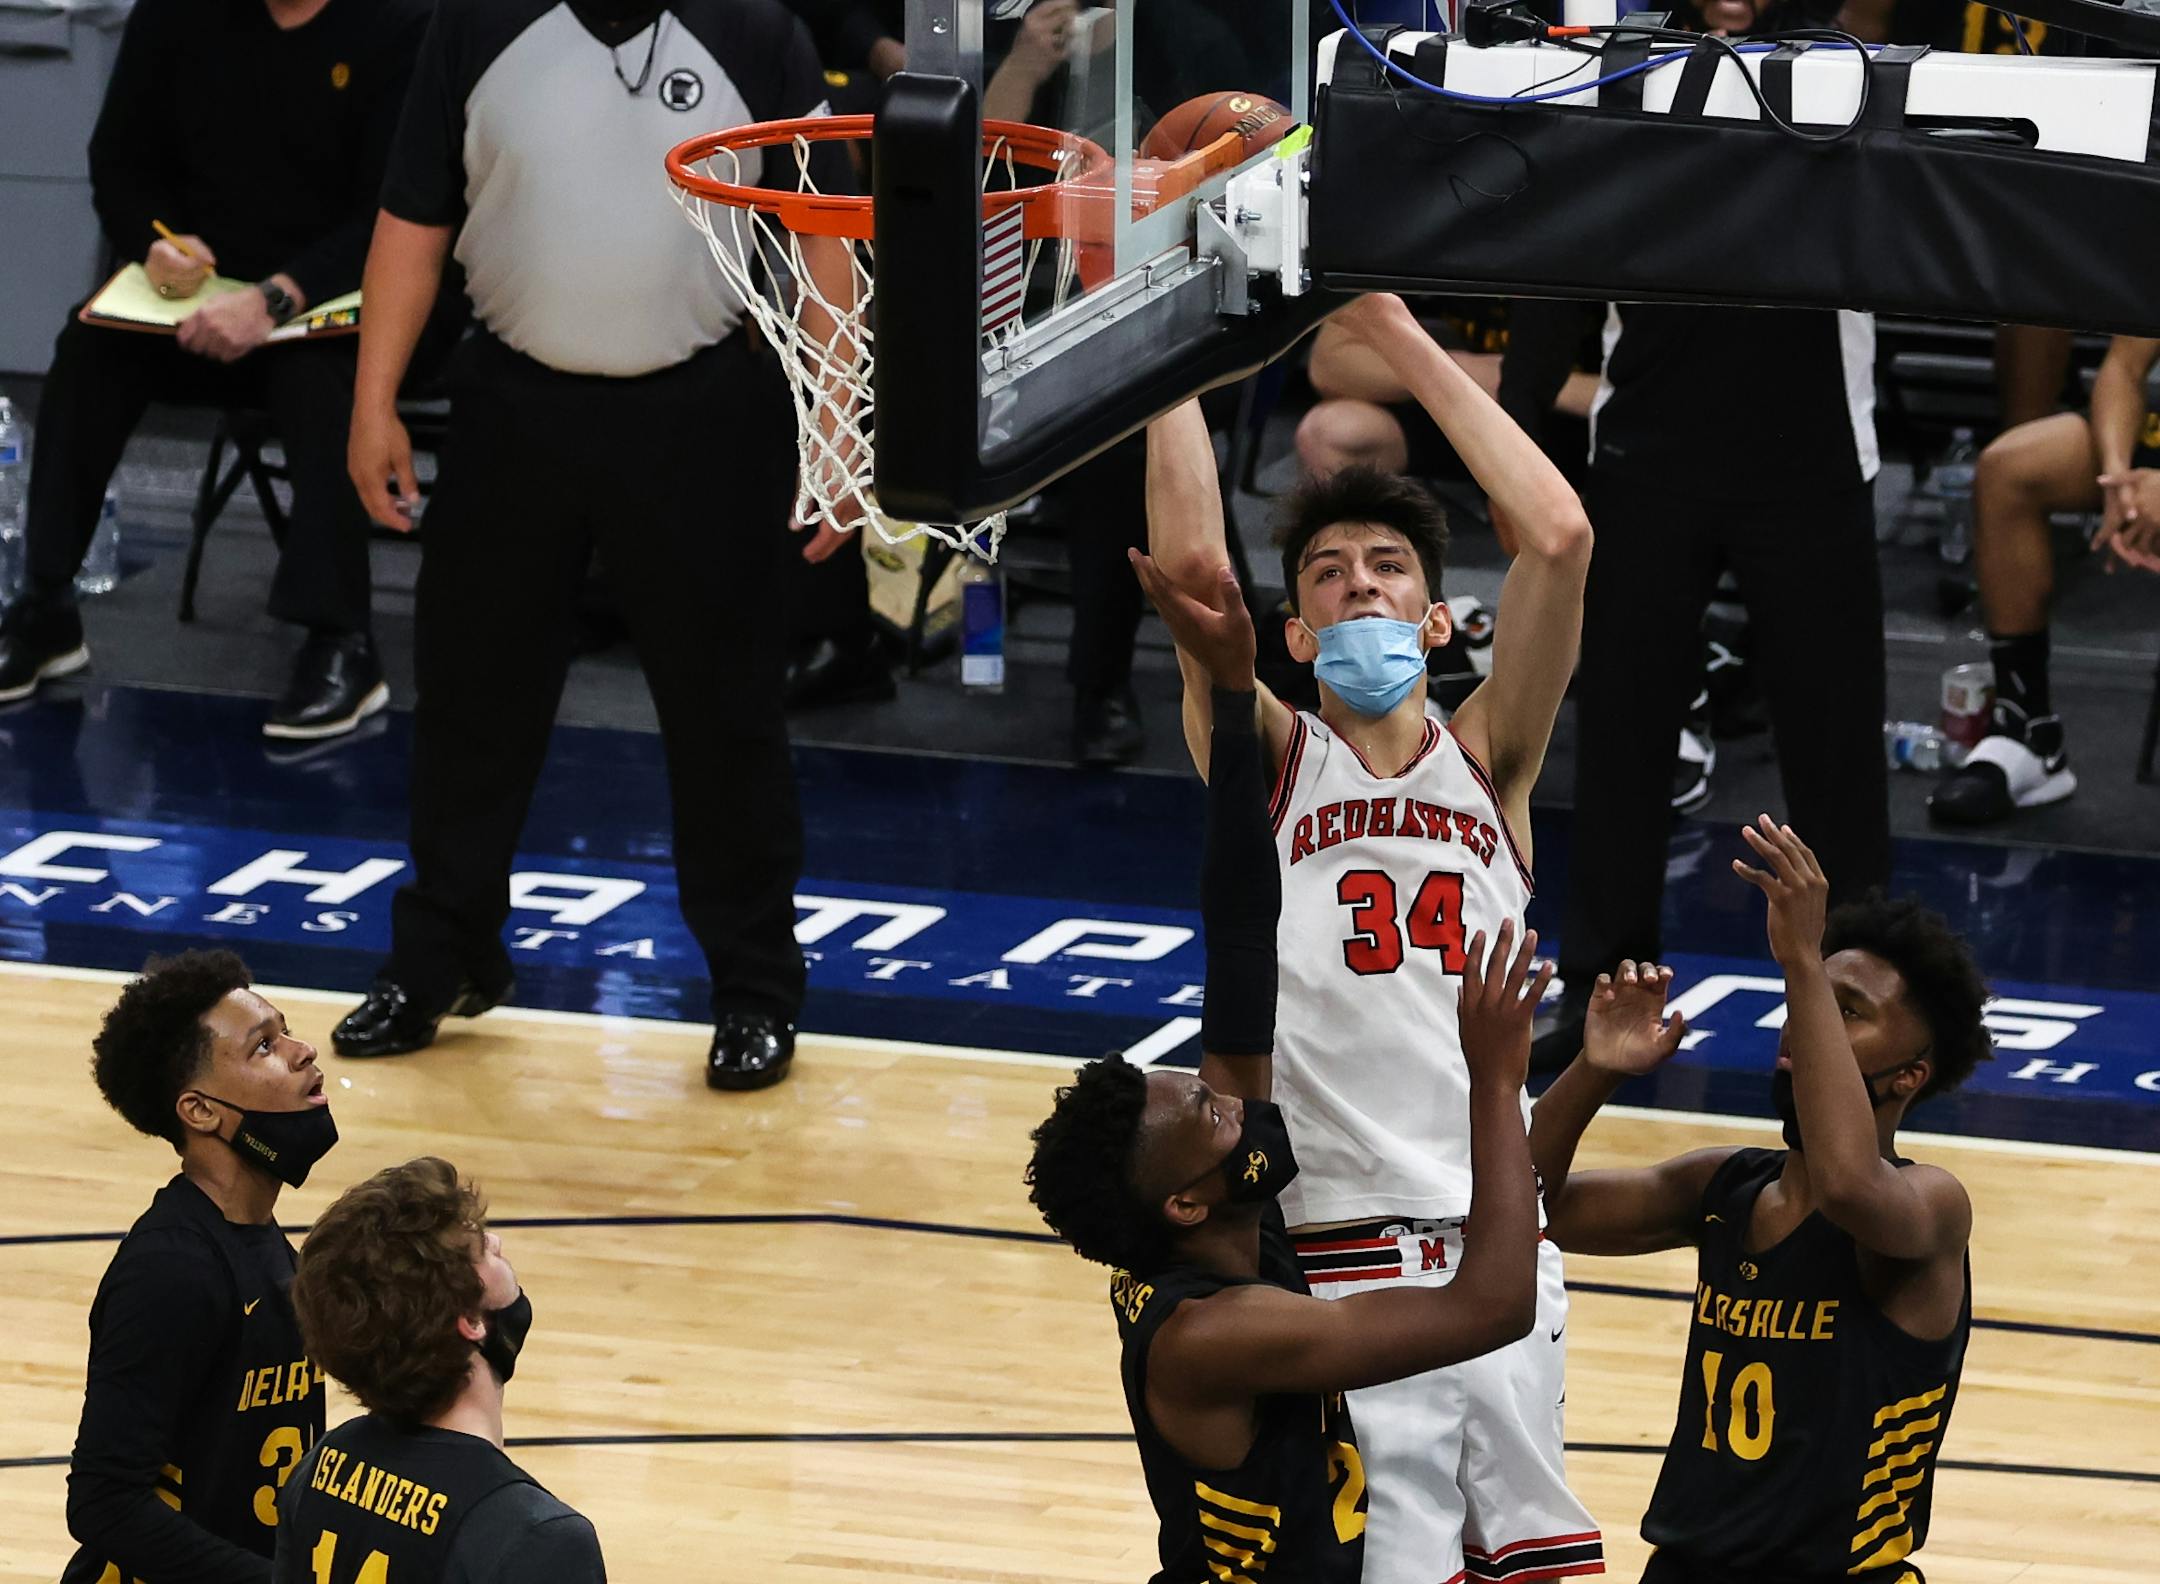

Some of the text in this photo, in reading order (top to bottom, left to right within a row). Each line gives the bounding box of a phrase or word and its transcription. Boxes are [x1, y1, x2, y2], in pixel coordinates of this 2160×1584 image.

[1290, 797, 1499, 869] REDHAWKS
[1336, 869, 1467, 976] 34
[802, 952, 1205, 1007] TATE
[1419, 1237, 1447, 1270] M
[1698, 1281, 1839, 1340] LASALLE
[1702, 1350, 1776, 1460] 10
[311, 1446, 448, 1536] ISLANDERS
[1328, 1440, 1367, 1544] 2
